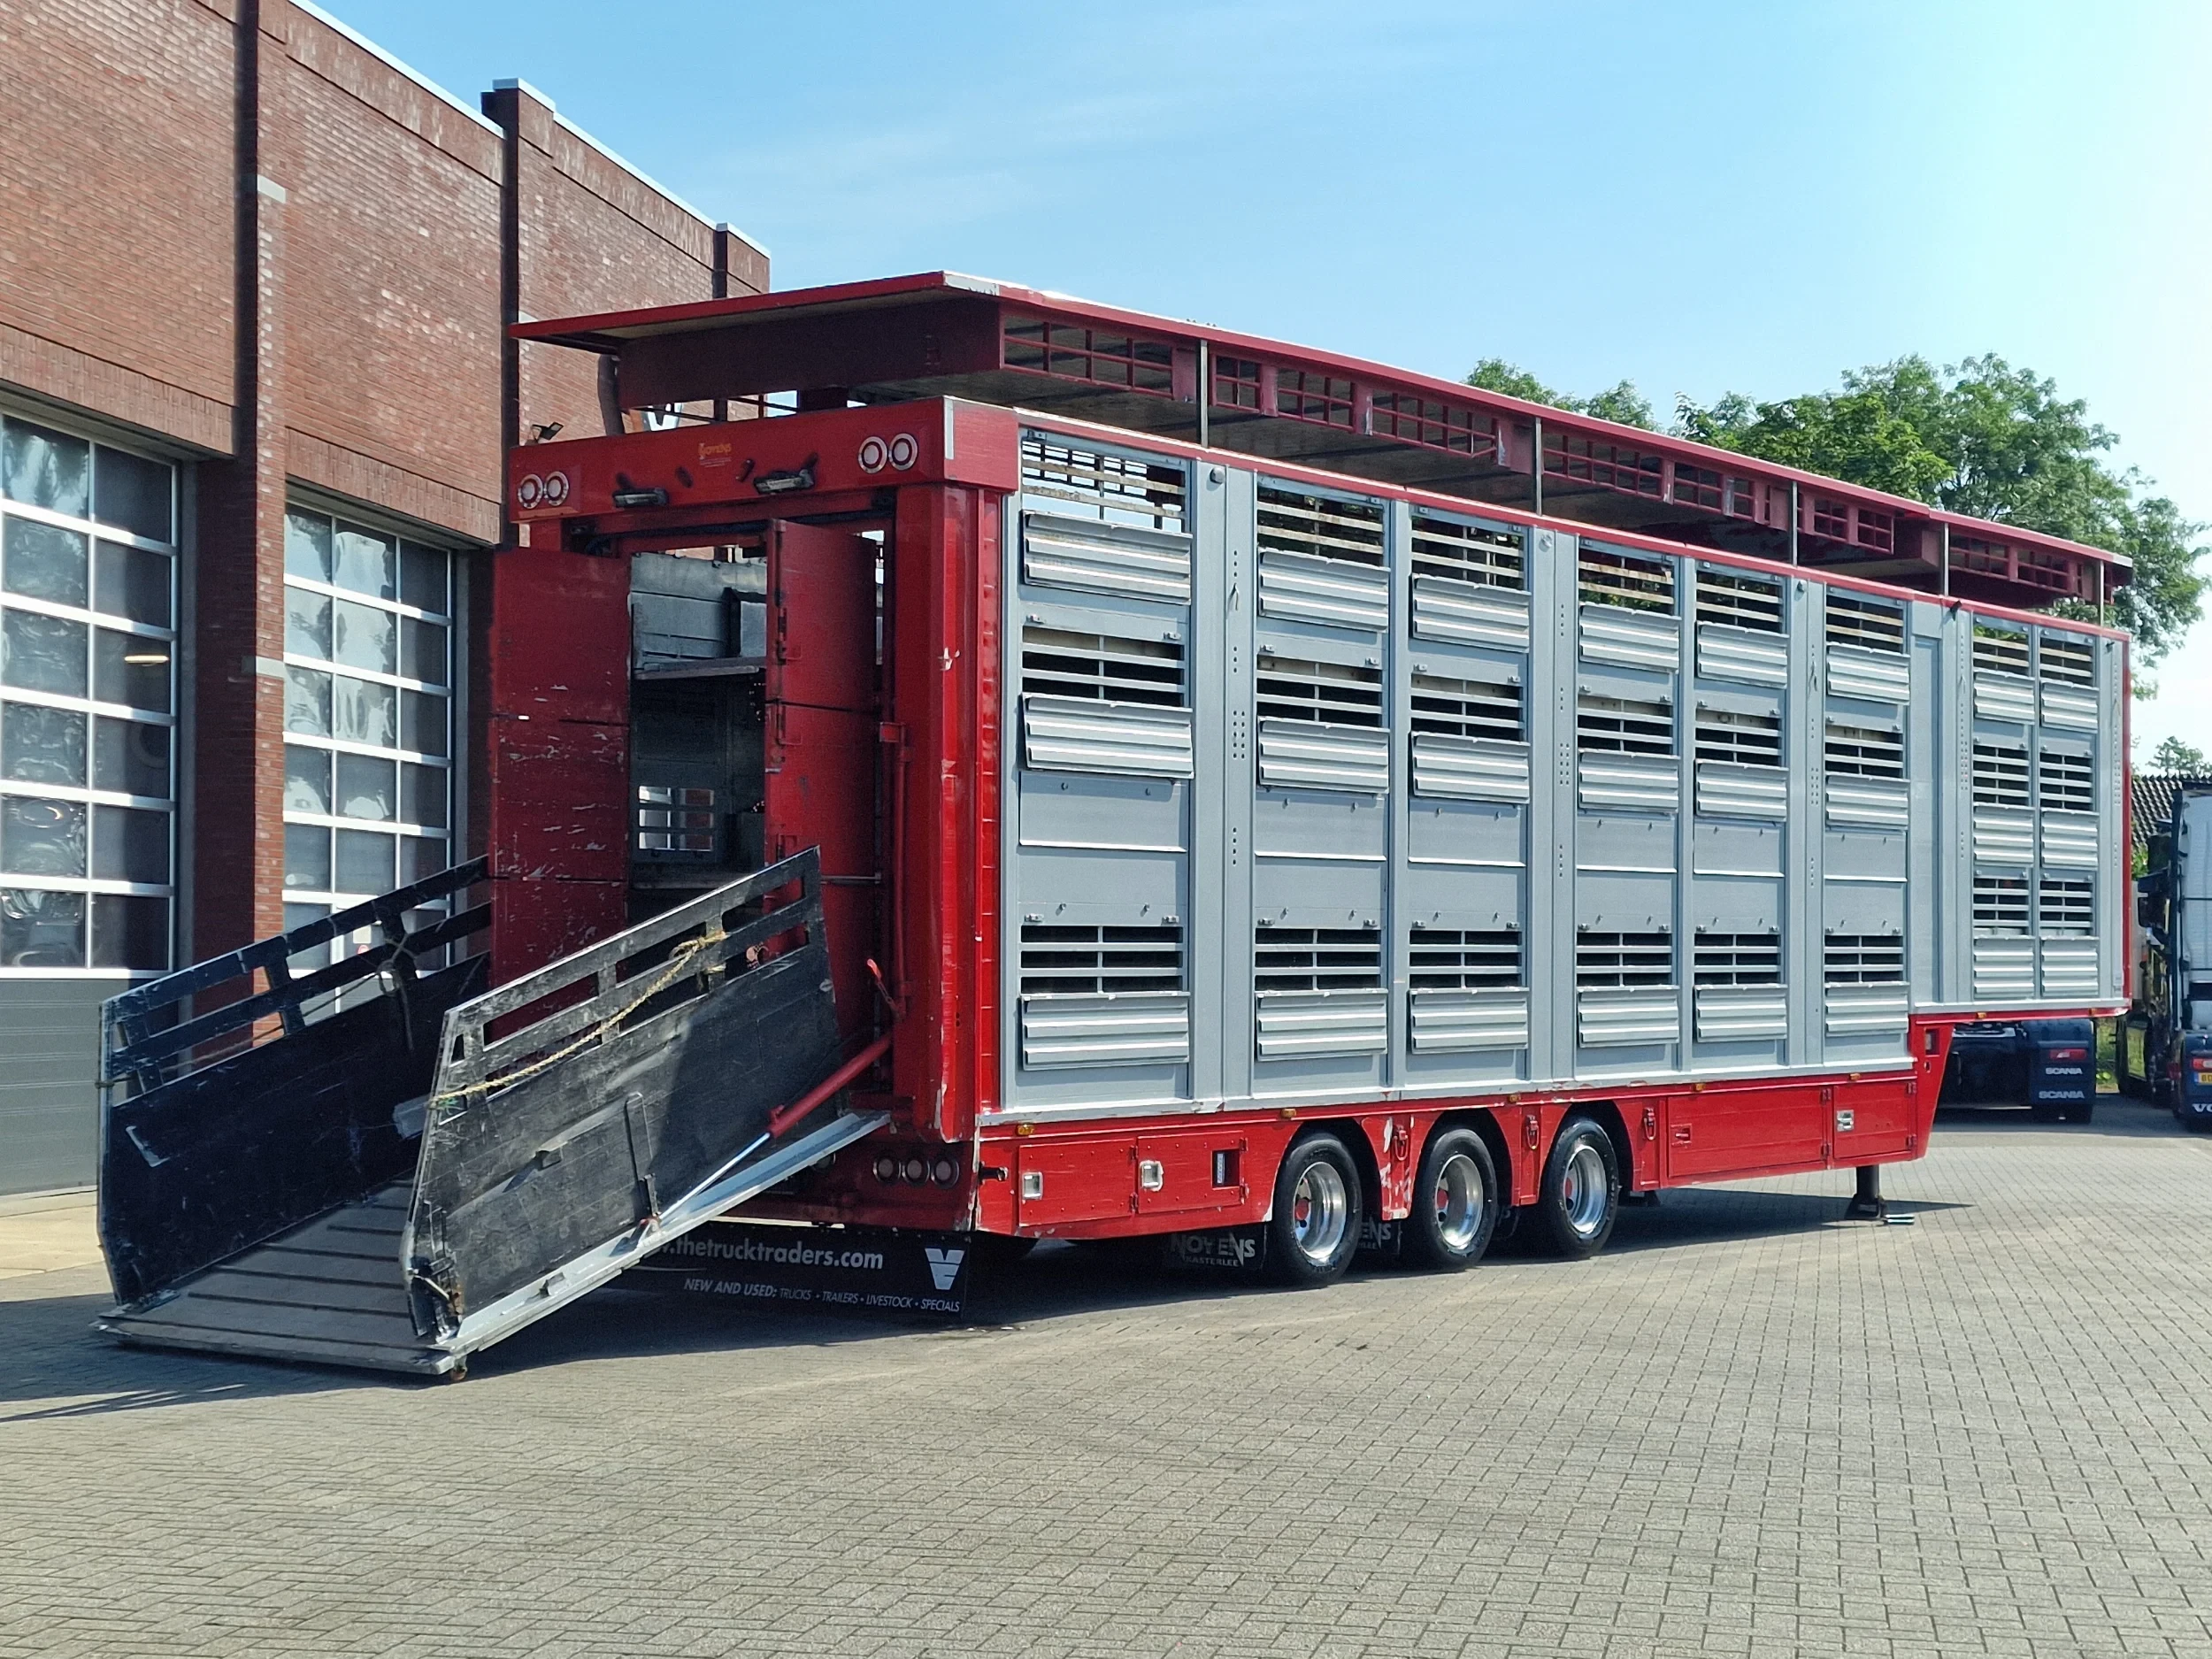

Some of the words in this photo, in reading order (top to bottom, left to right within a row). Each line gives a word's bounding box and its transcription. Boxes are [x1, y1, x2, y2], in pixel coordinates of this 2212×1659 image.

[2039, 1090, 2085, 1099] SCANIA
[683, 1279, 712, 1292] NEW
[714, 1281, 741, 1294] AND
[744, 1284, 777, 1297] USED:
[780, 1288, 812, 1301] TRUCKS
[822, 1291, 859, 1304] TRAILERS
[866, 1294, 914, 1308] LIVESTOCK
[920, 1299, 960, 1312] SPECIALS
